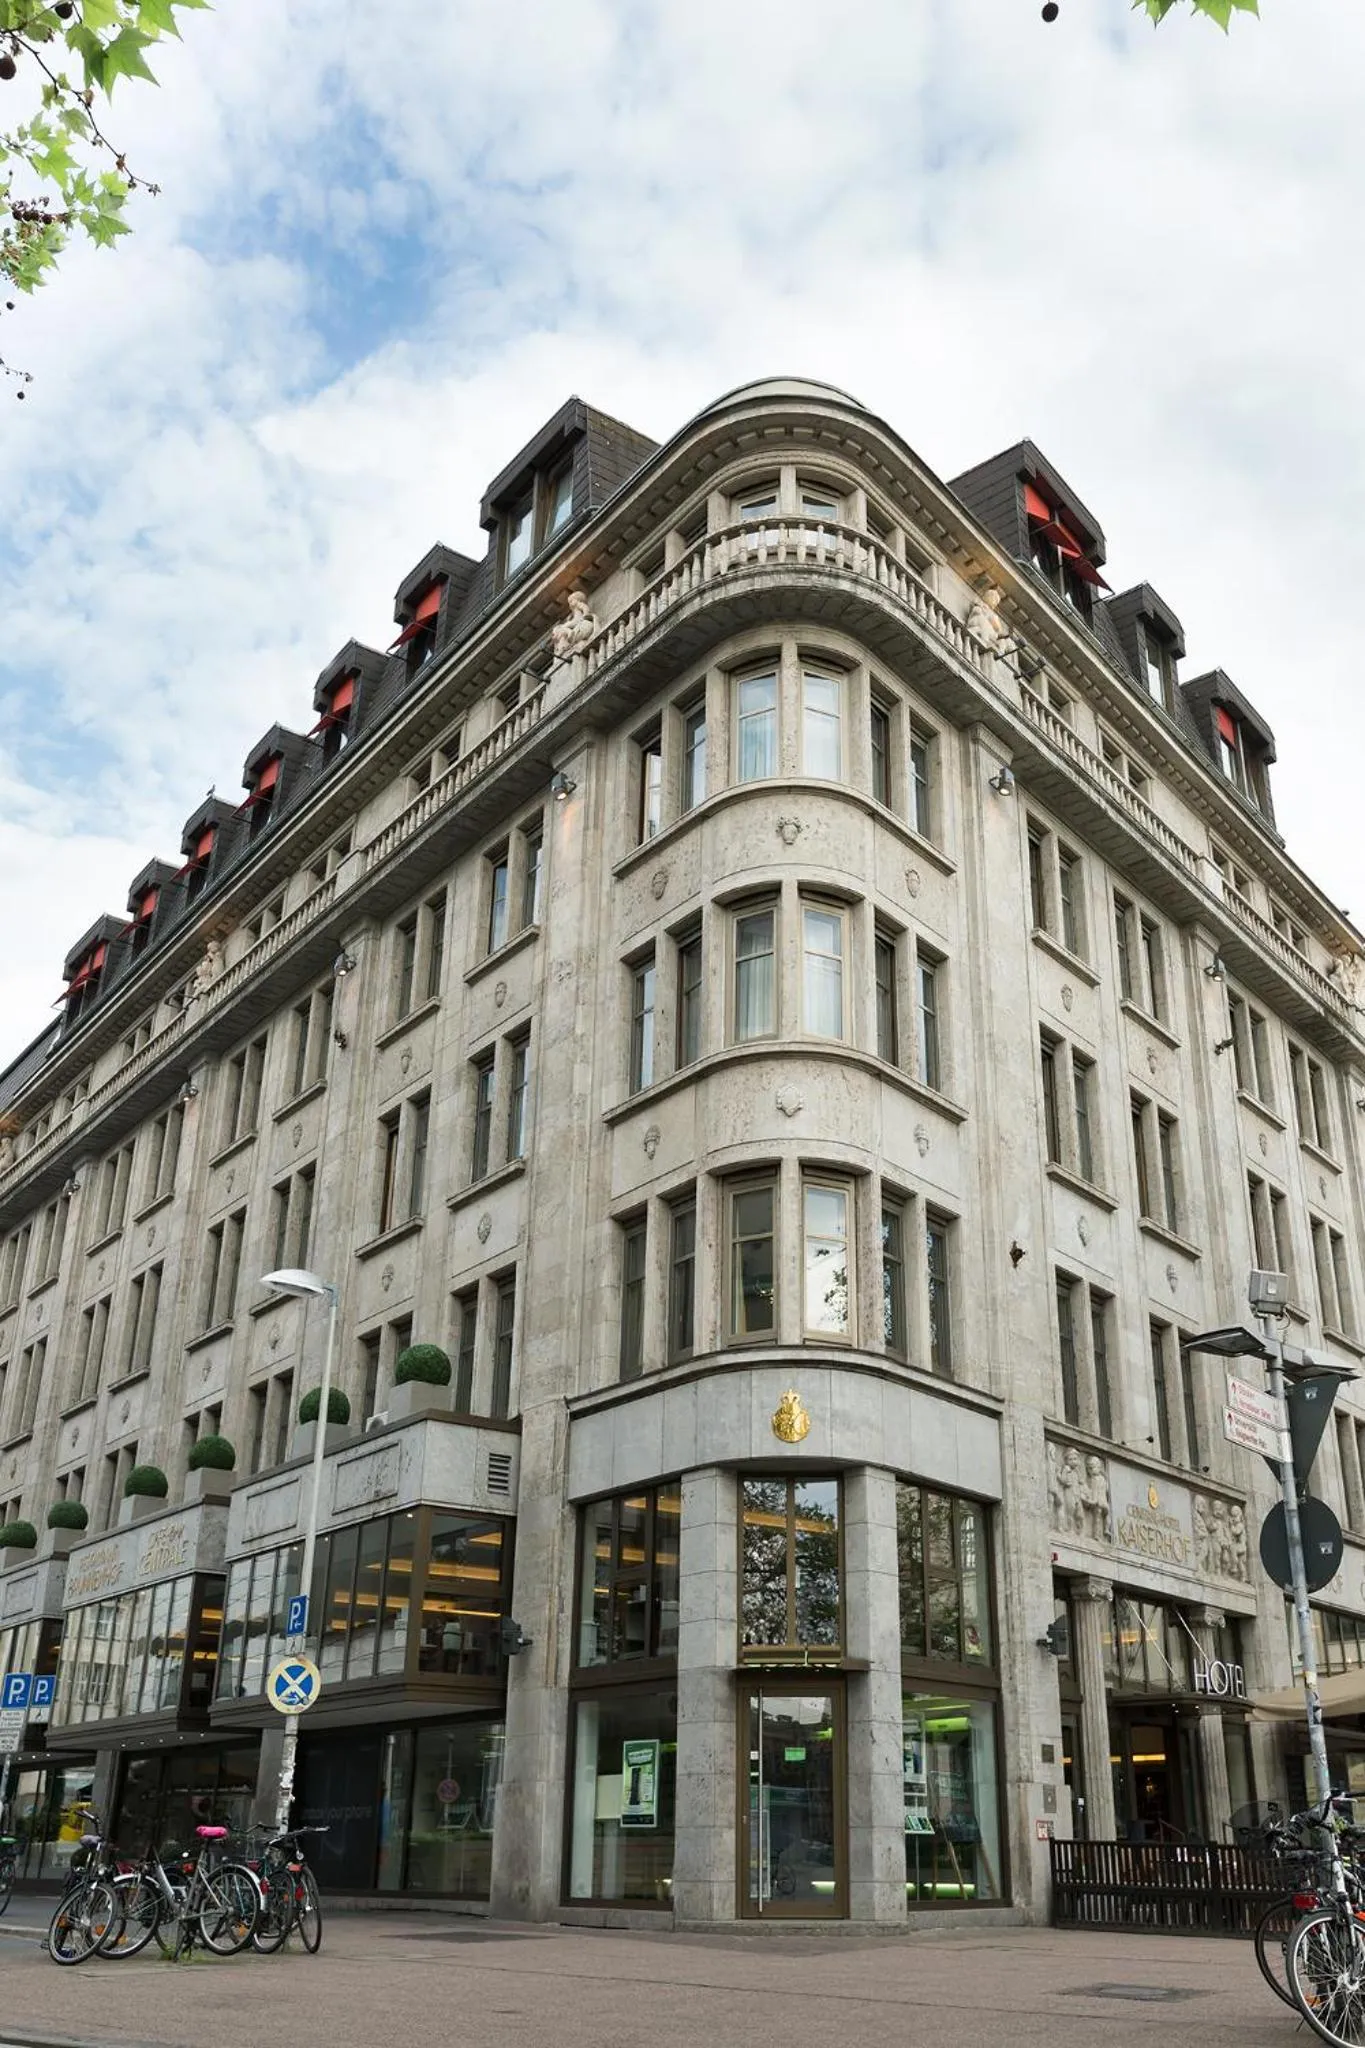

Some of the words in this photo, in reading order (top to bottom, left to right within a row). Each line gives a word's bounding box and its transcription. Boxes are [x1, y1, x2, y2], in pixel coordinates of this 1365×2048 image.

[1117, 1517, 1191, 1563] KAISERHOF
[289, 1602, 301, 1631] P
[8, 1678, 26, 1705] P
[35, 1679, 49, 1703] P
[1193, 1658, 1248, 1700] HOTEL
